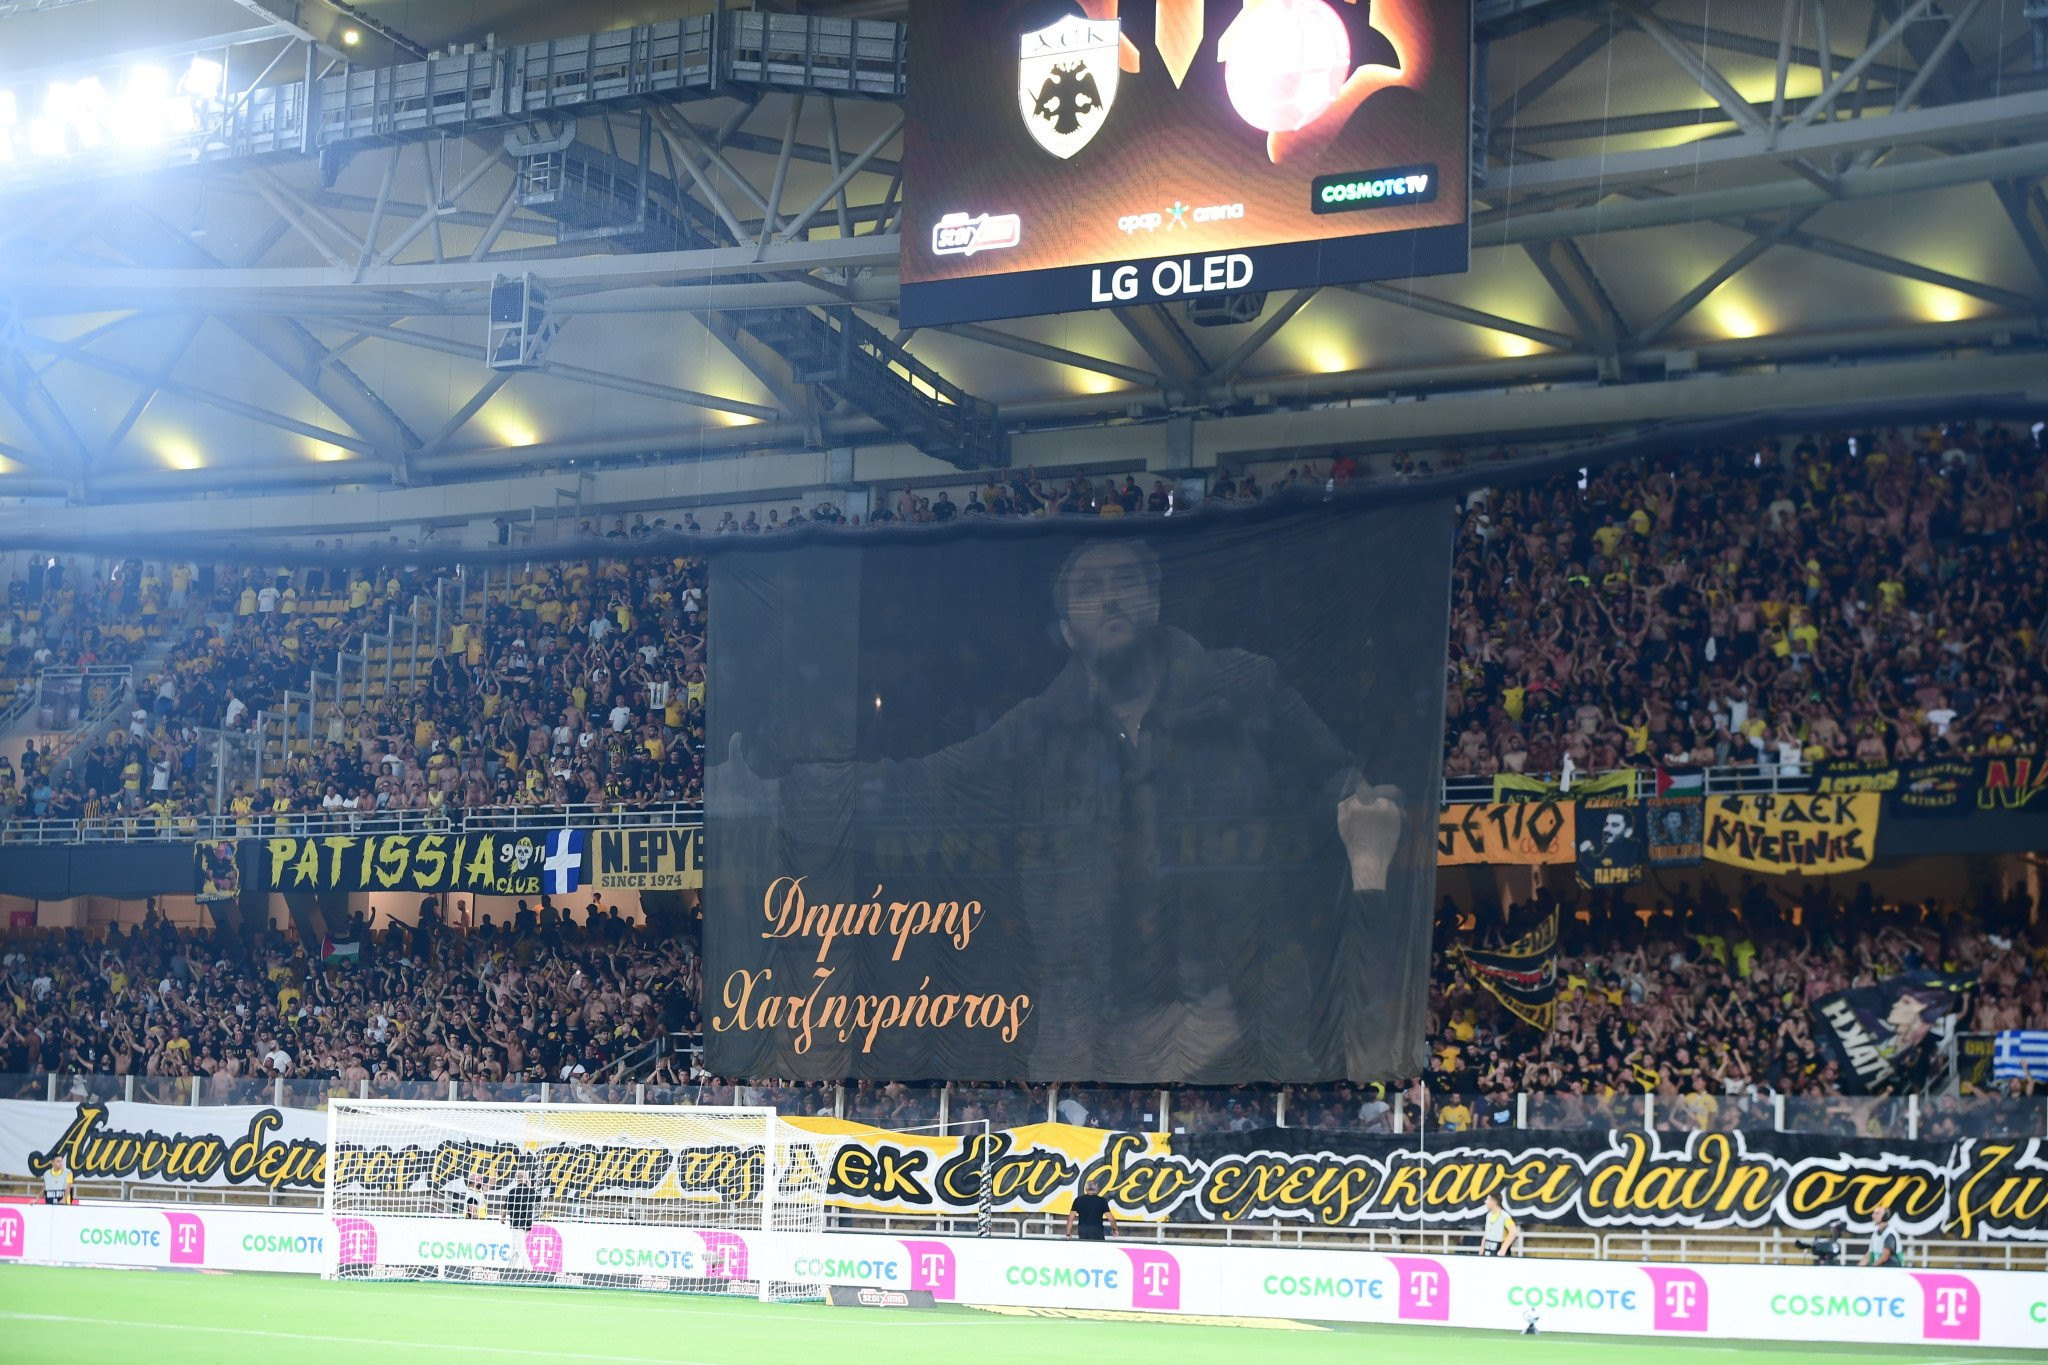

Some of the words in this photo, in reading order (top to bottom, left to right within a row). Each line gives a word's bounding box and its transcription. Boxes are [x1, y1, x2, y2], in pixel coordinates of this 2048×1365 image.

[1118, 212, 1162, 234] opap
[1193, 203, 1244, 223] arena
[1091, 265, 1138, 302] LG
[1152, 253, 1254, 296] OLED
[265, 833, 495, 891] PATISSIA
[496, 877, 541, 895] CLUB
[602, 876, 647, 888] SINCE
[650, 874, 682, 887] 1974
[761, 875, 986, 963] Δημήτρης
[712, 967, 1034, 1054] Χατζηχρήστος
[1084, 1136, 1194, 1202] δεν
[1208, 1163, 1376, 1226] εχεις
[1381, 1159, 1577, 1207] κανει
[1793, 1171, 1945, 1216] στη
[0, 1217, 17, 1246] T
[80, 1228, 161, 1247] COSMOTE
[178, 1223, 197, 1253] T
[348, 1229, 369, 1262] T
[418, 1240, 511, 1262] COSMOTE
[531, 1236, 553, 1268] T
[596, 1247, 694, 1270] COSMOTE
[920, 1253, 946, 1287] T
[1006, 1265, 1118, 1290] COSMOTE
[1143, 1262, 1169, 1296] T
[1264, 1274, 1383, 1299] COSMOTE
[1410, 1270, 1439, 1307] T
[1508, 1285, 1636, 1311] COSMOTE
[1666, 1280, 1696, 1319] T
[1771, 1294, 1905, 1318] COSMOTE
[1935, 1287, 1967, 1326] T
